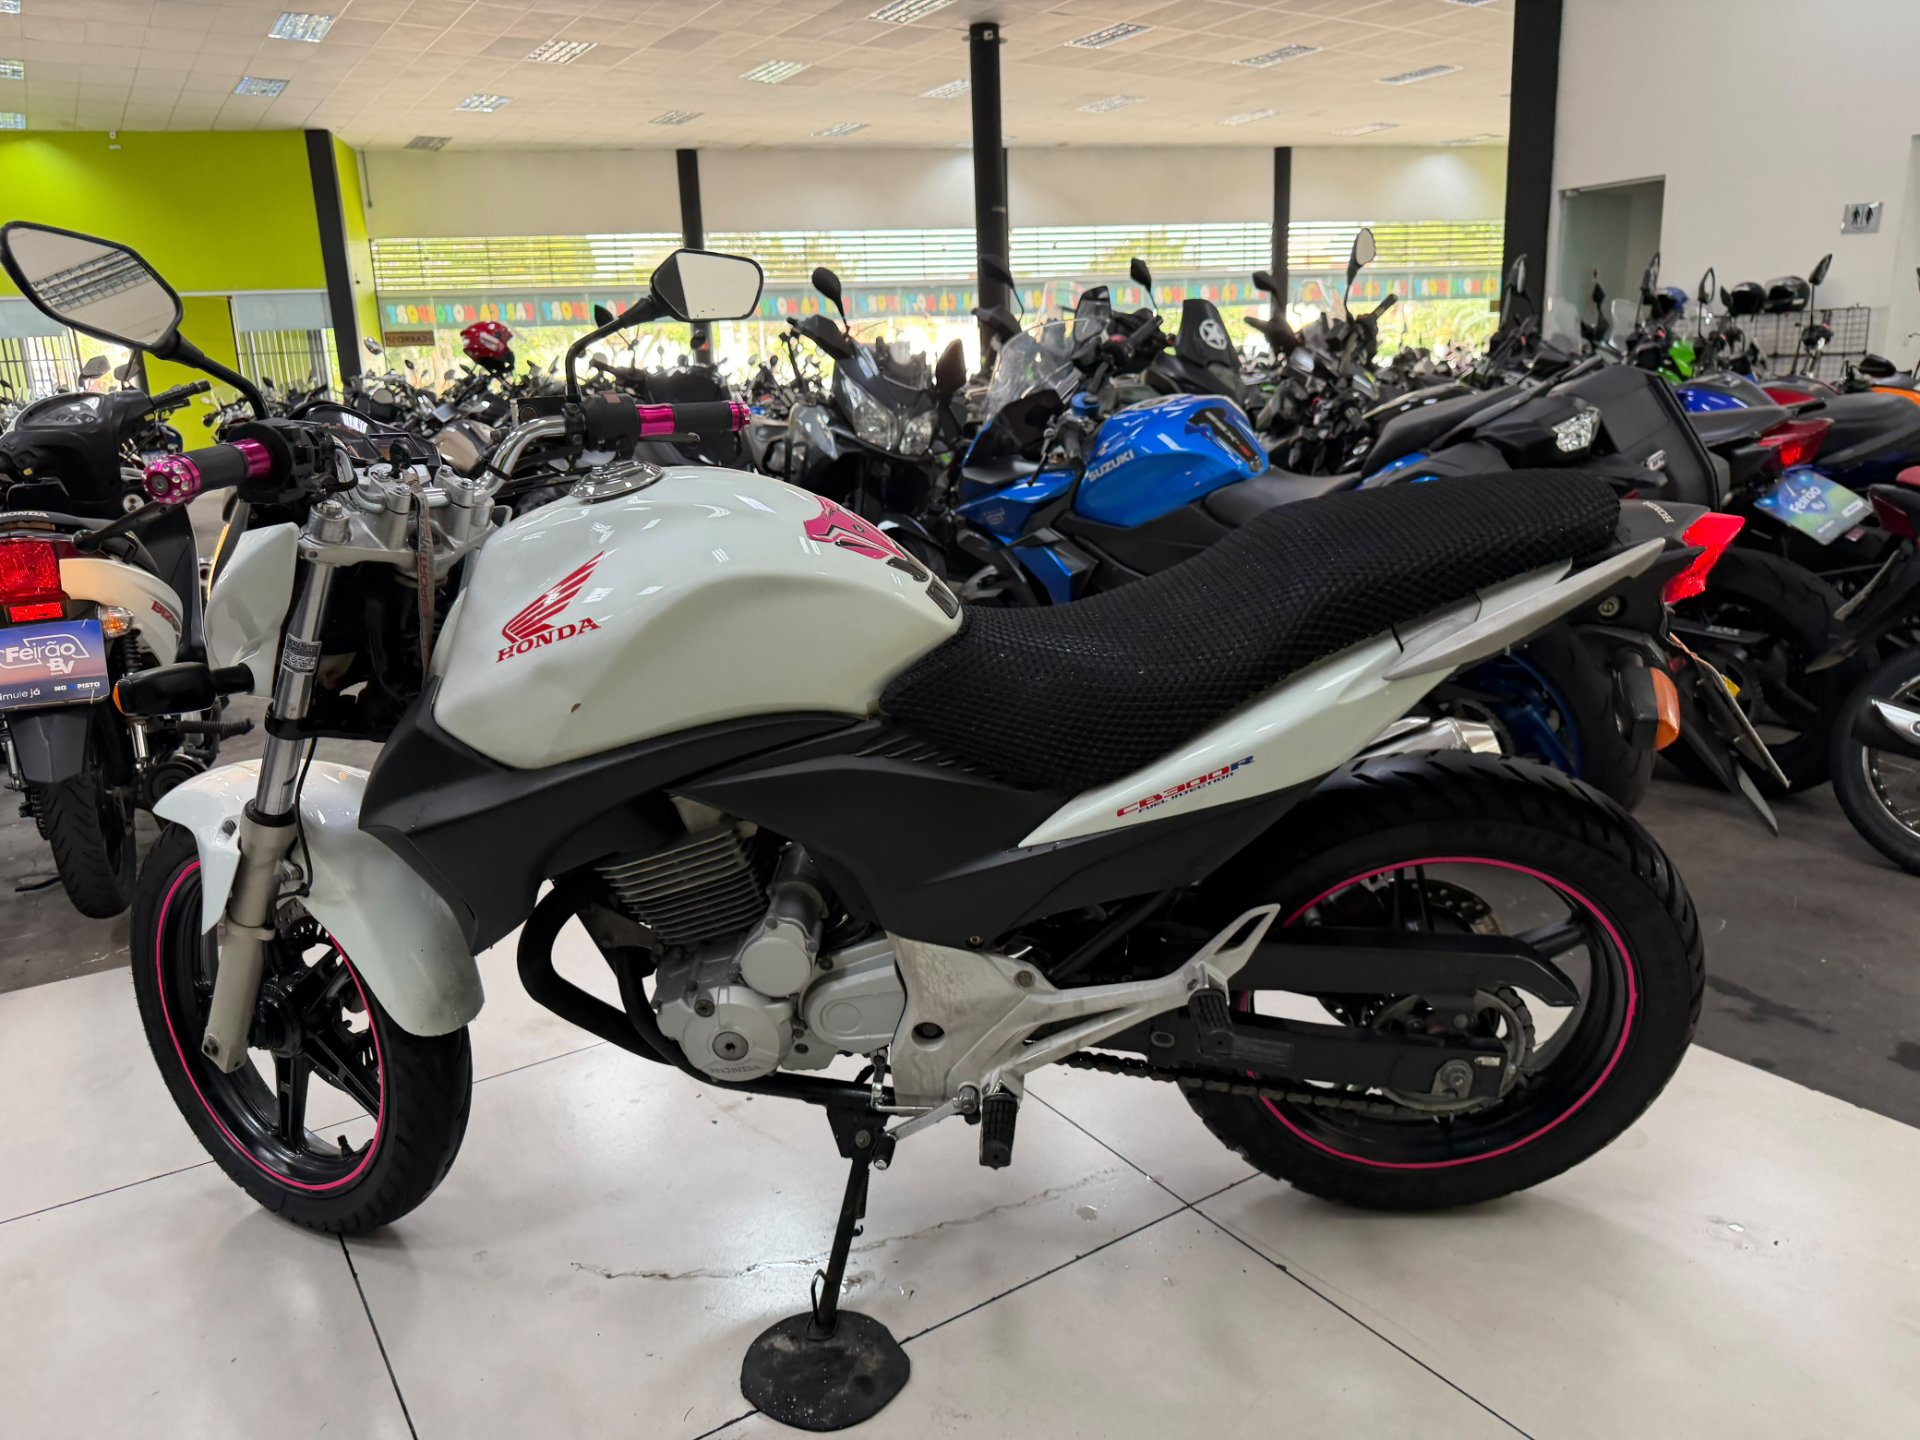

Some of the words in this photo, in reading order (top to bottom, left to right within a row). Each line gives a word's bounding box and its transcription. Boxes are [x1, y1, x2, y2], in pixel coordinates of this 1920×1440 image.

[1088, 449, 1135, 482] SUZUKI
[5, 641, 76, 663] Feirão
[496, 617, 602, 663] HONDA
[48, 657, 75, 675] BV
[0, 690, 29, 700] imule
[30, 687, 41, 698] já
[1116, 755, 1256, 817] CB300R
